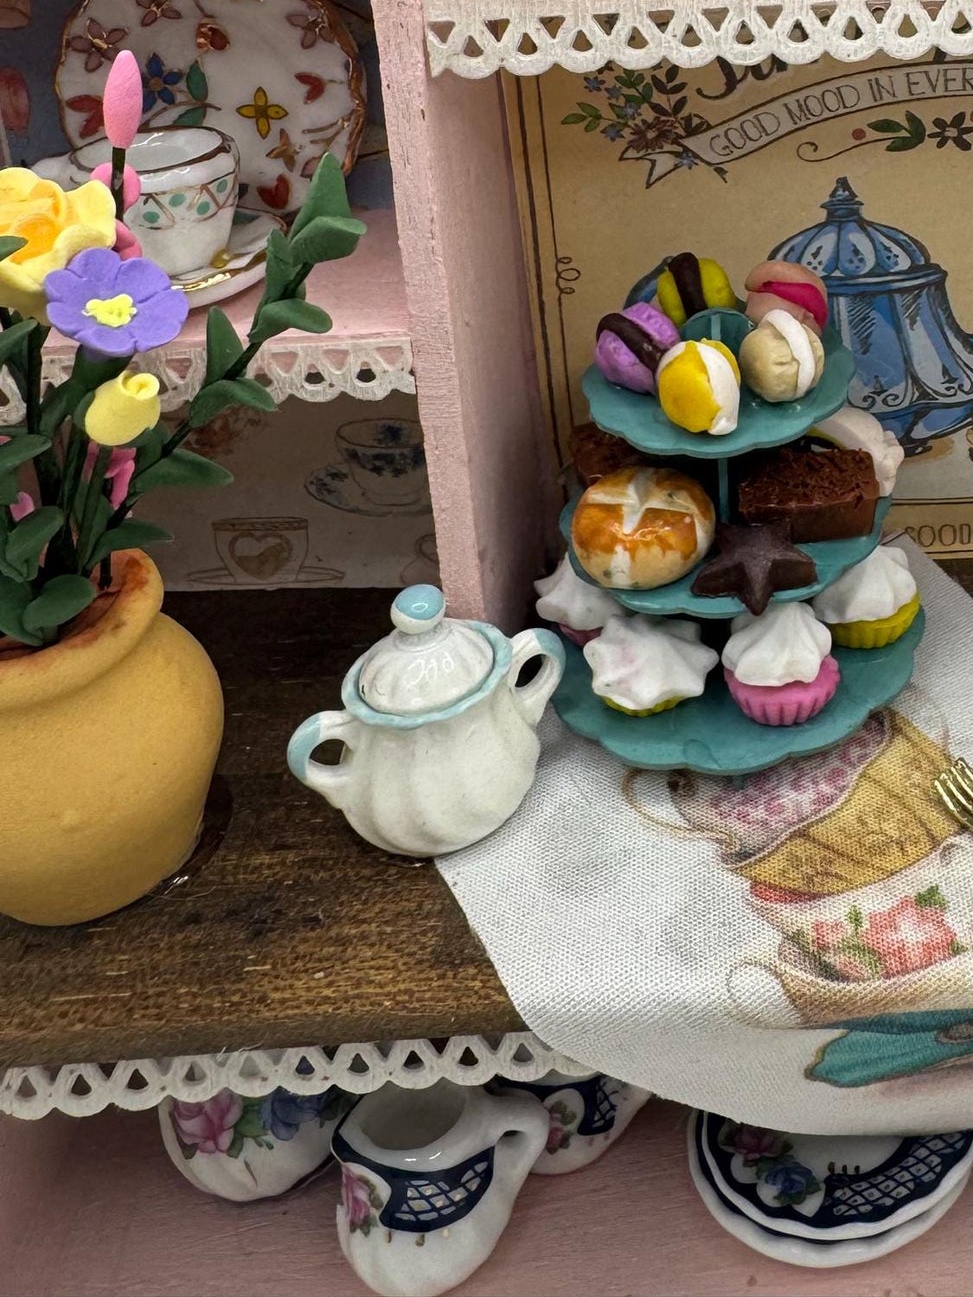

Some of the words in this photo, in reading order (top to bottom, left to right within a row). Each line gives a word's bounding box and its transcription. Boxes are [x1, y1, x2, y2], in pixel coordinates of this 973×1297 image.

[708, 111, 781, 157] GOOD
[782, 84, 860, 126] MOOD
[867, 74, 898, 103] IN
